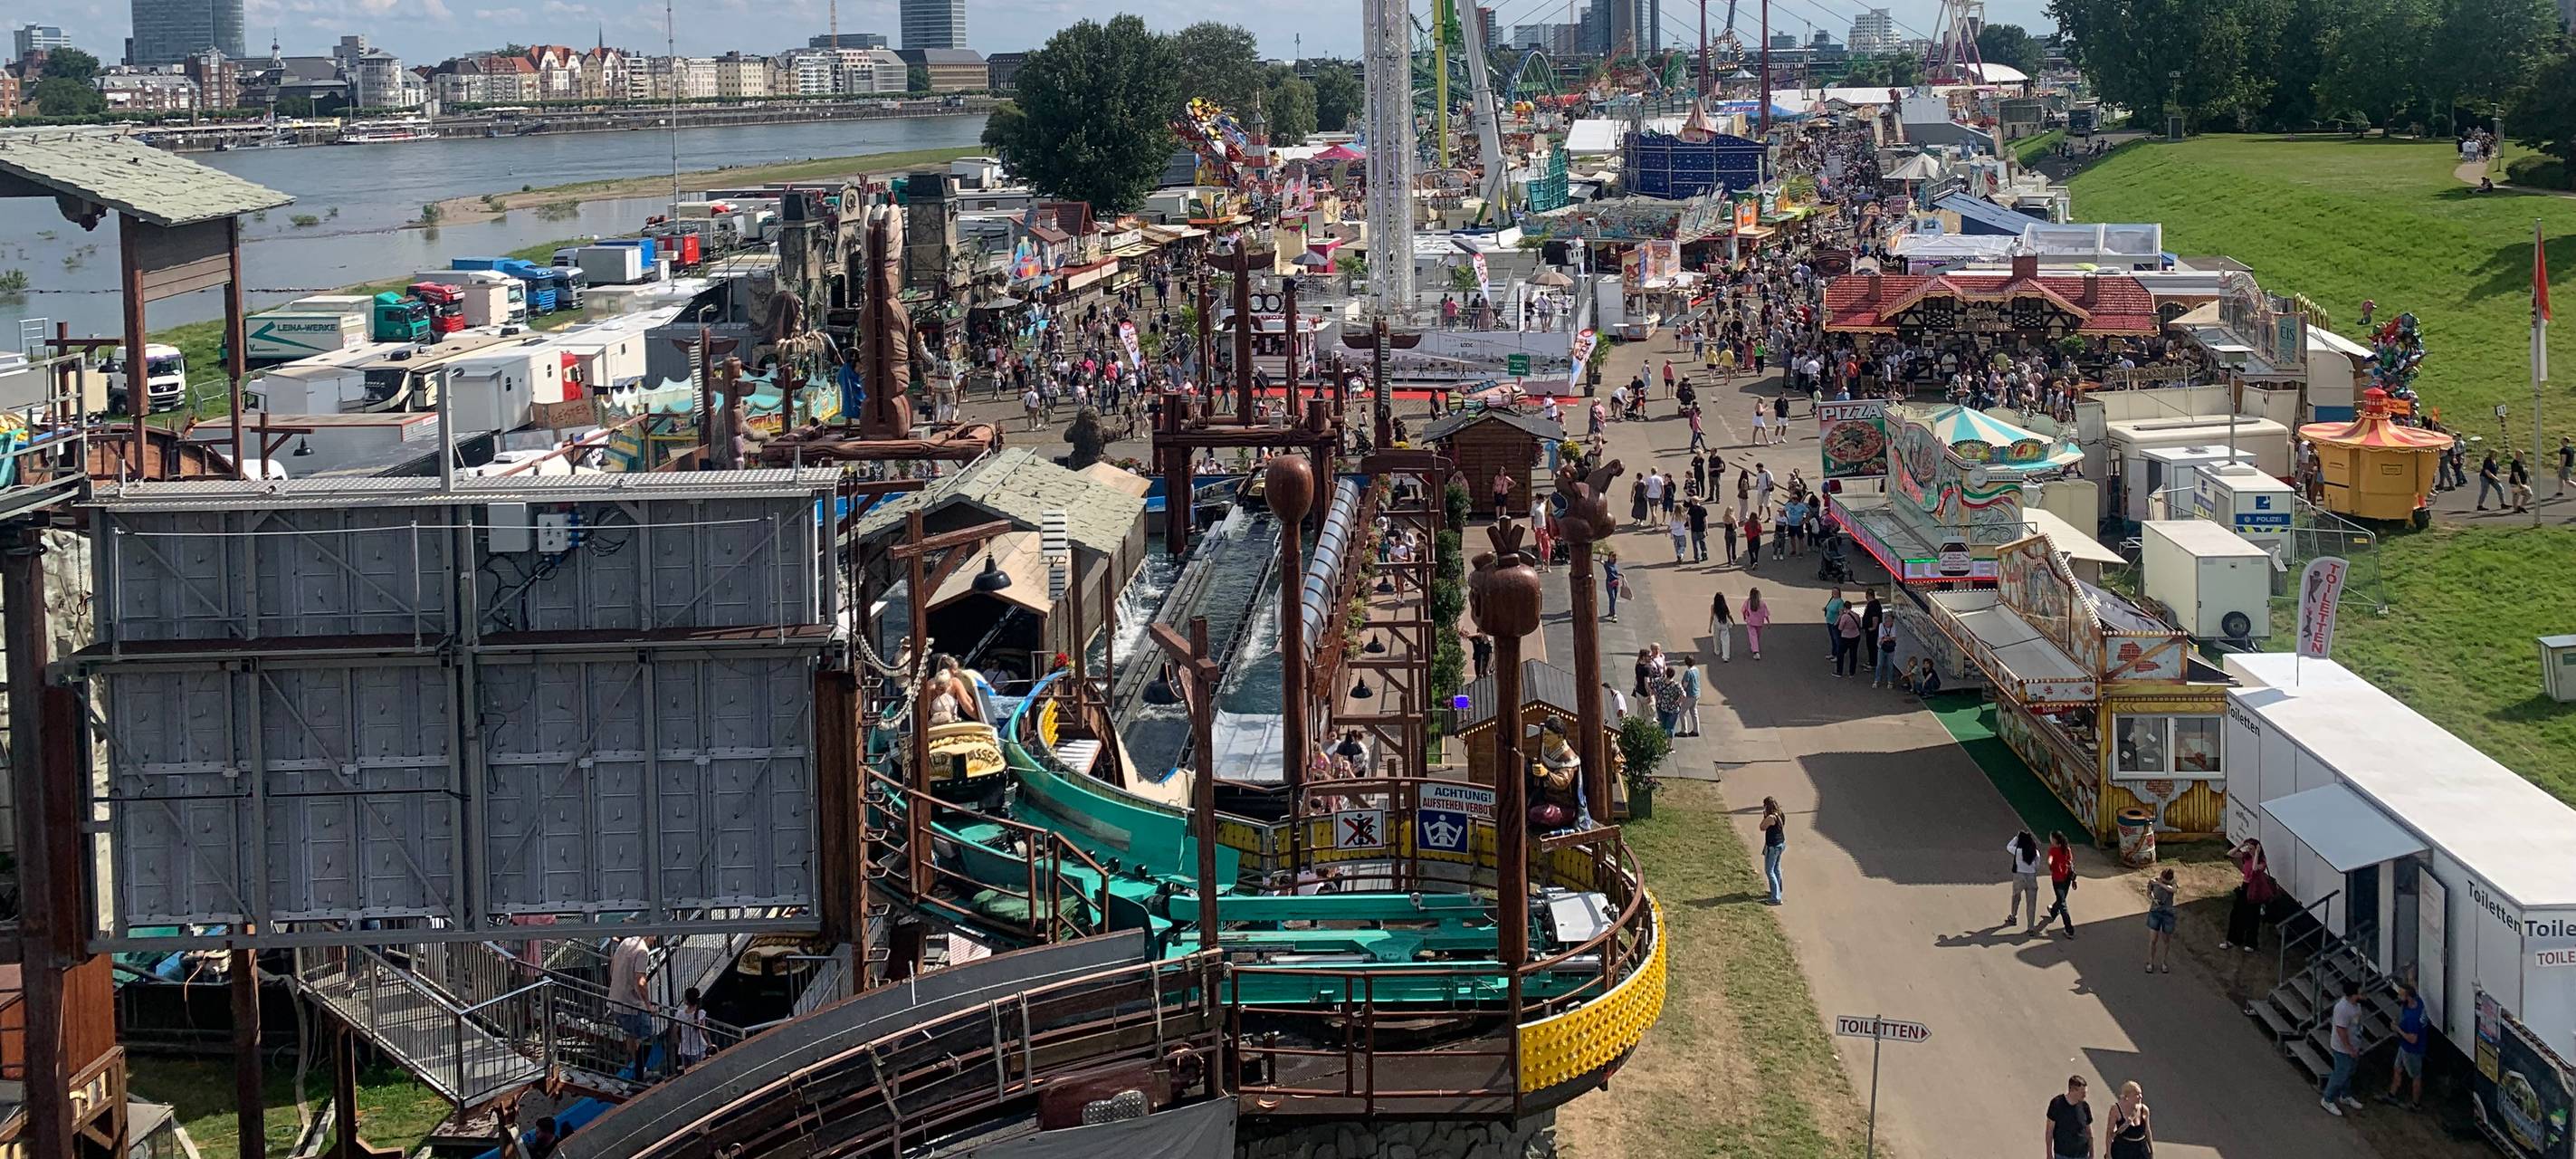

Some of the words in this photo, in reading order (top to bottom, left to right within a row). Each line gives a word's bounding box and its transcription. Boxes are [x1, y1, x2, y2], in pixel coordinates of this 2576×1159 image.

[277, 323, 337, 331] LEINA-WERKE
[2280, 326, 2295, 341] EIS
[1821, 405, 1884, 420] PIZZA
[2312, 563, 2340, 654] TOILETTEN
[2227, 702, 2260, 737] Toiletten
[1435, 787, 1492, 803] ACHTUNG!
[1423, 798, 1464, 811] AUFSTEHEN
[2467, 880, 2522, 935] Toiletten
[2524, 919, 2576, 937] Toile
[2537, 951, 2576, 966] TOILE
